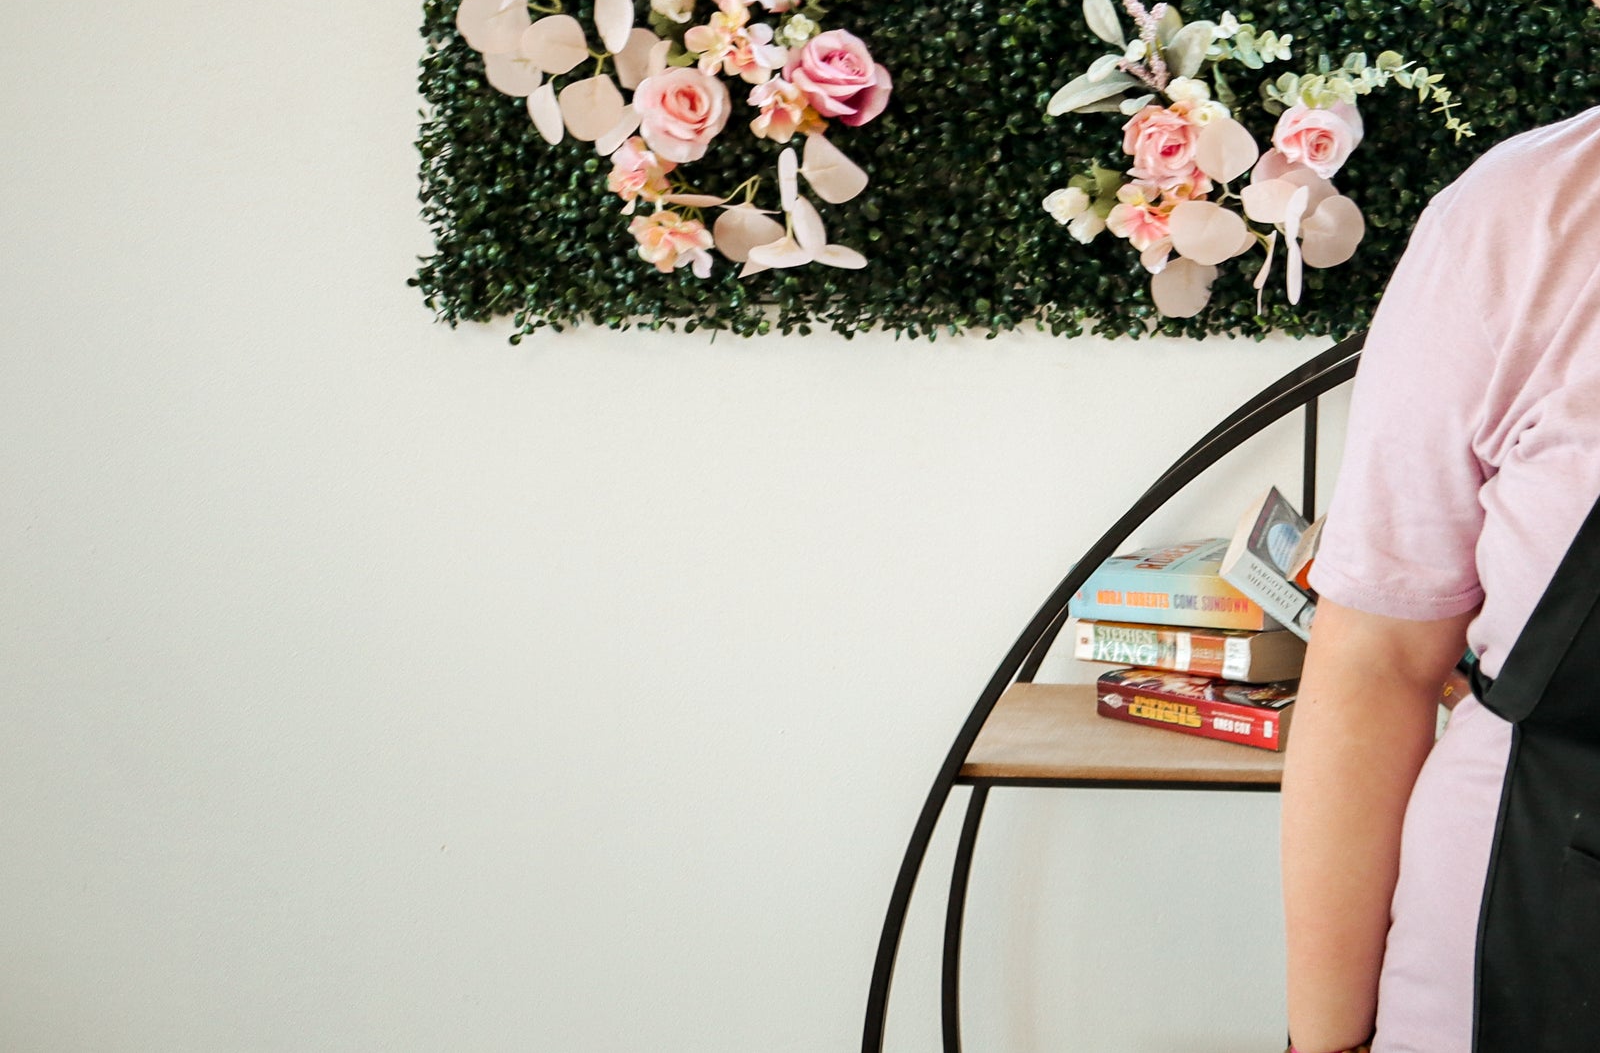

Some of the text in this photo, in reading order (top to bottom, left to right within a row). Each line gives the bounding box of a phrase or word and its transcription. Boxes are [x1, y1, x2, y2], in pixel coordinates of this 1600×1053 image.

[1248, 562, 1283, 592] MARGOT
[1173, 593, 1198, 611] COME
[1201, 595, 1249, 613] SUNDOWN
[1096, 625, 1155, 645] STEPHEN
[1096, 640, 1154, 665] KING
